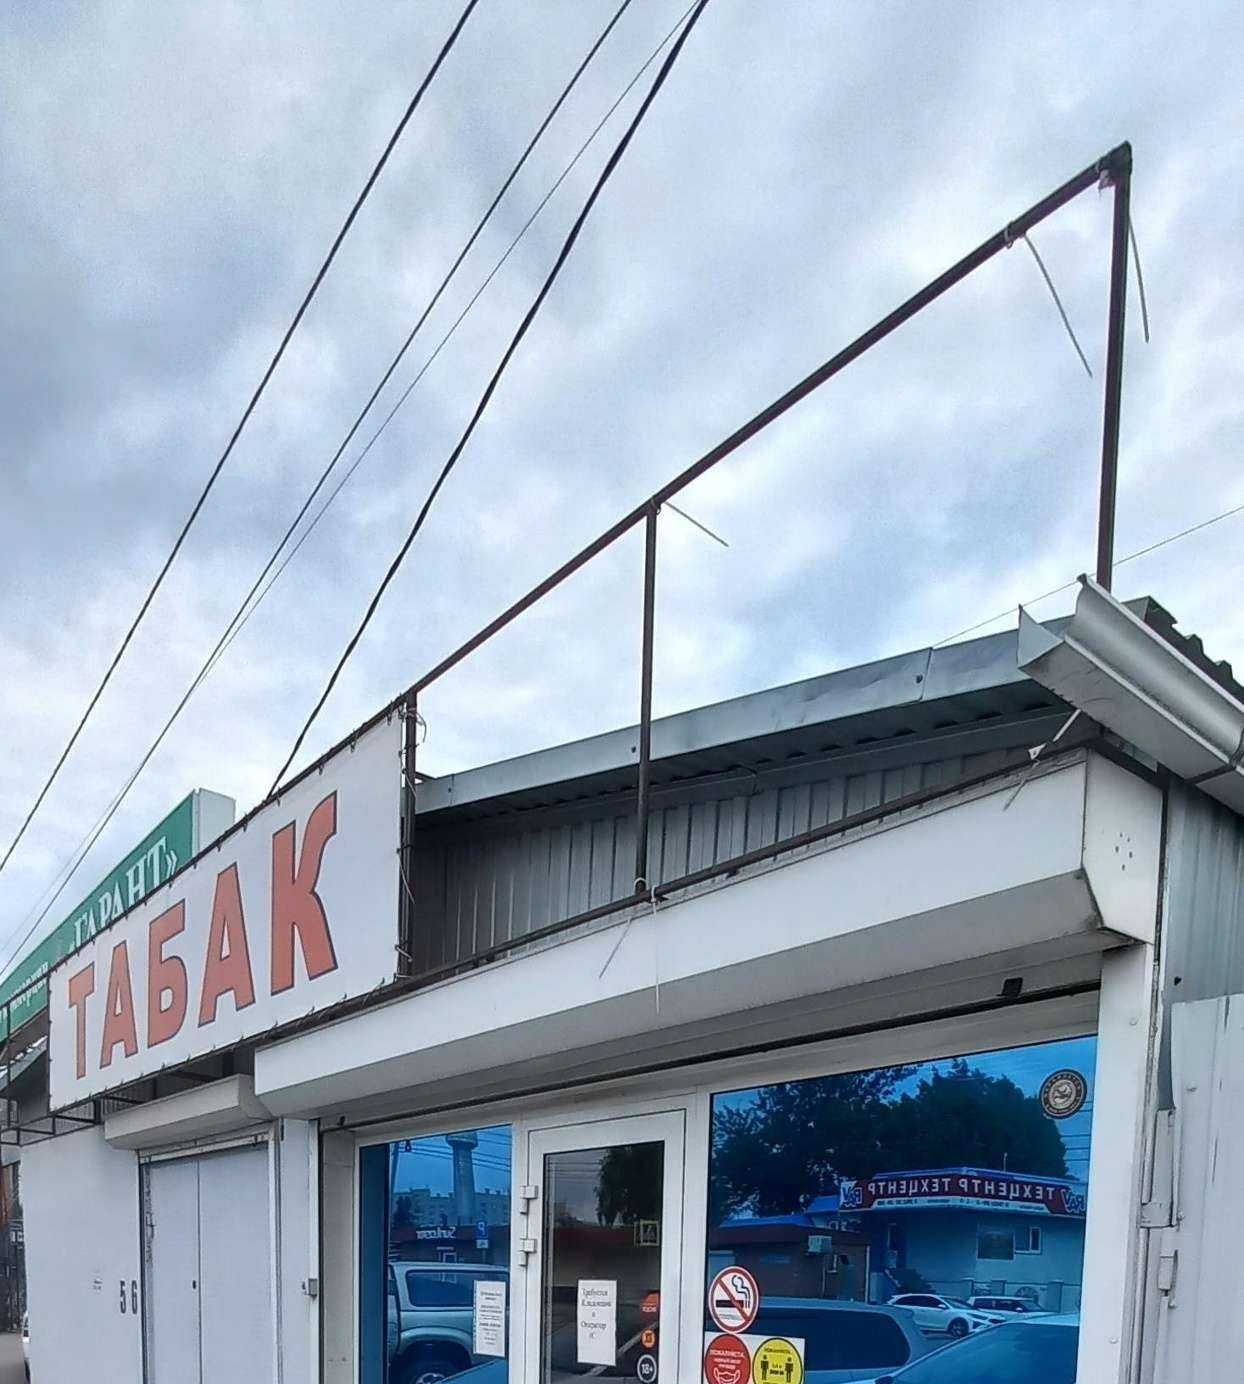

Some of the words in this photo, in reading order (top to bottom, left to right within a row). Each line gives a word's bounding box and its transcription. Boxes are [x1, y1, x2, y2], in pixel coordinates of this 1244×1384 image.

[68, 790, 338, 1080] ТАБАК
[70, 836, 178, 953] ГАРАНТ»
[641, 1363, 653, 1375] 18+
